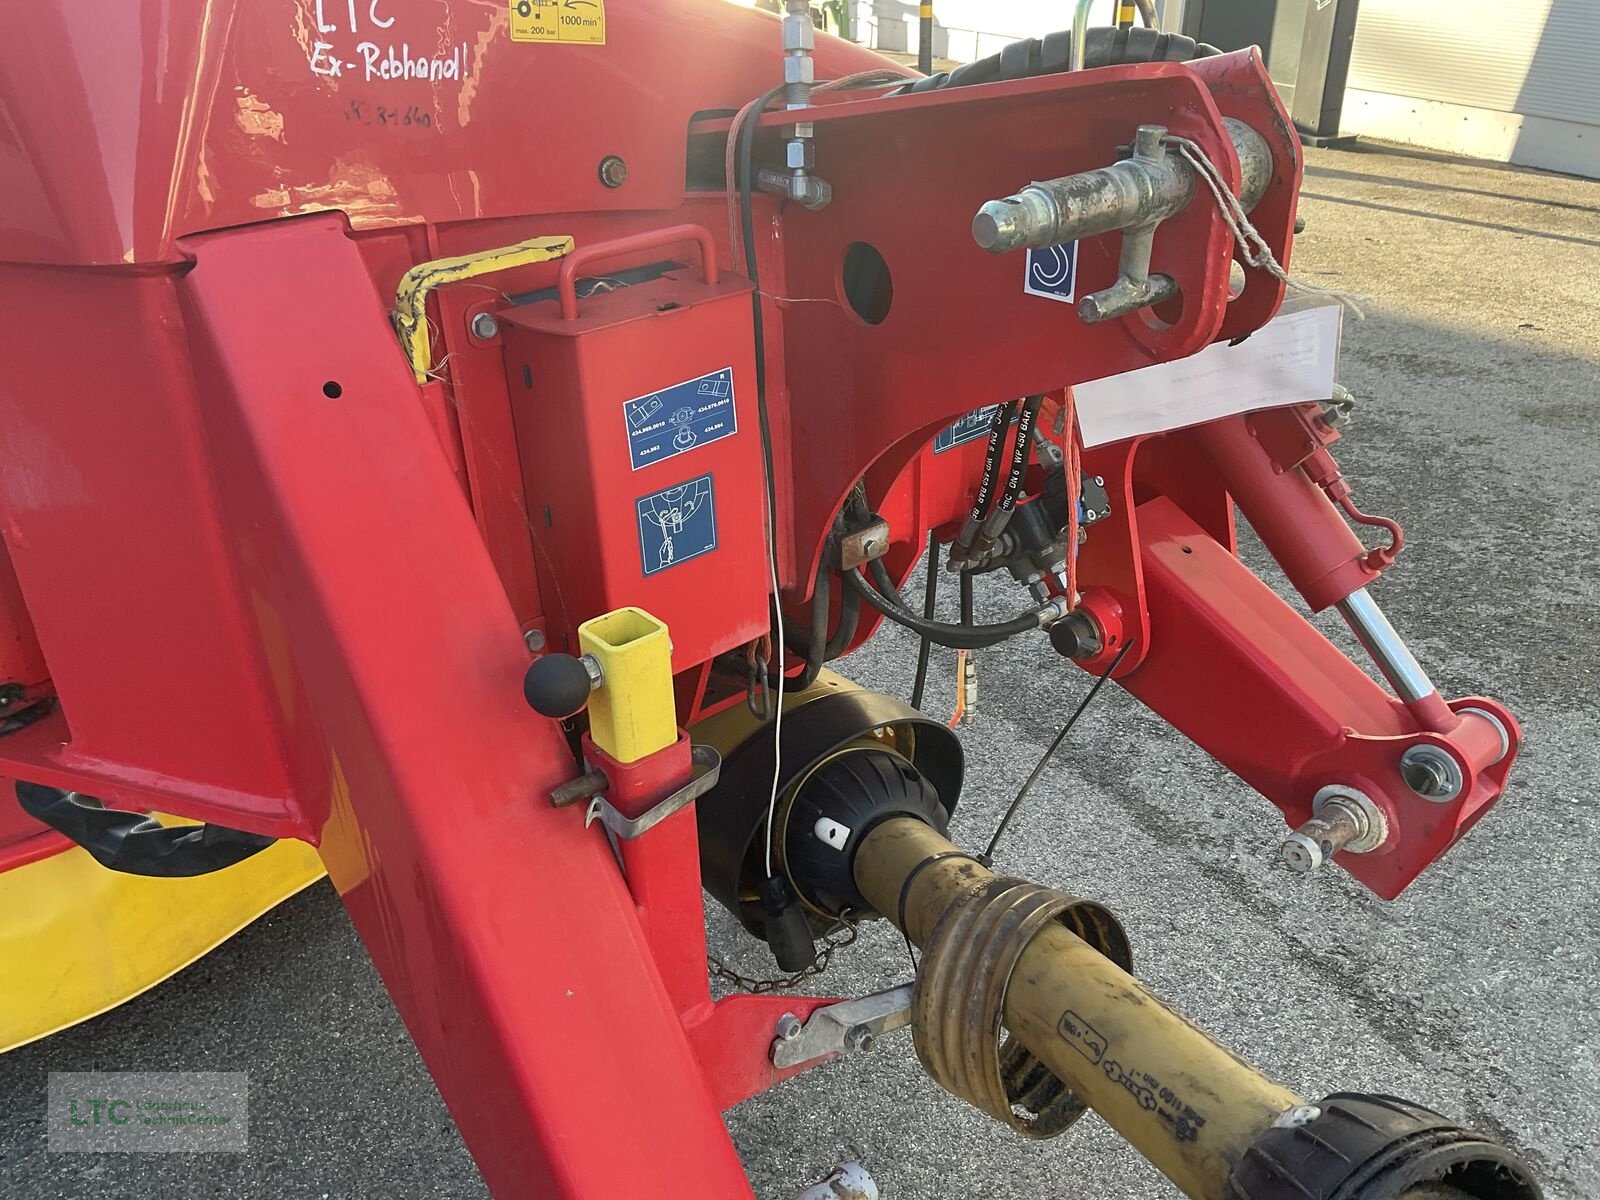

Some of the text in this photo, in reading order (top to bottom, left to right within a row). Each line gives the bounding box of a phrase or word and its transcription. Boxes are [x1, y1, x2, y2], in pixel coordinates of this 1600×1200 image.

[560, 16, 581, 26] 1000
[531, 26, 545, 35] 200
[1019, 409, 1032, 431] BAR
[1016, 432, 1026, 449] 450
[1014, 449, 1023, 463] WP
[1009, 477, 1018, 488] DN
